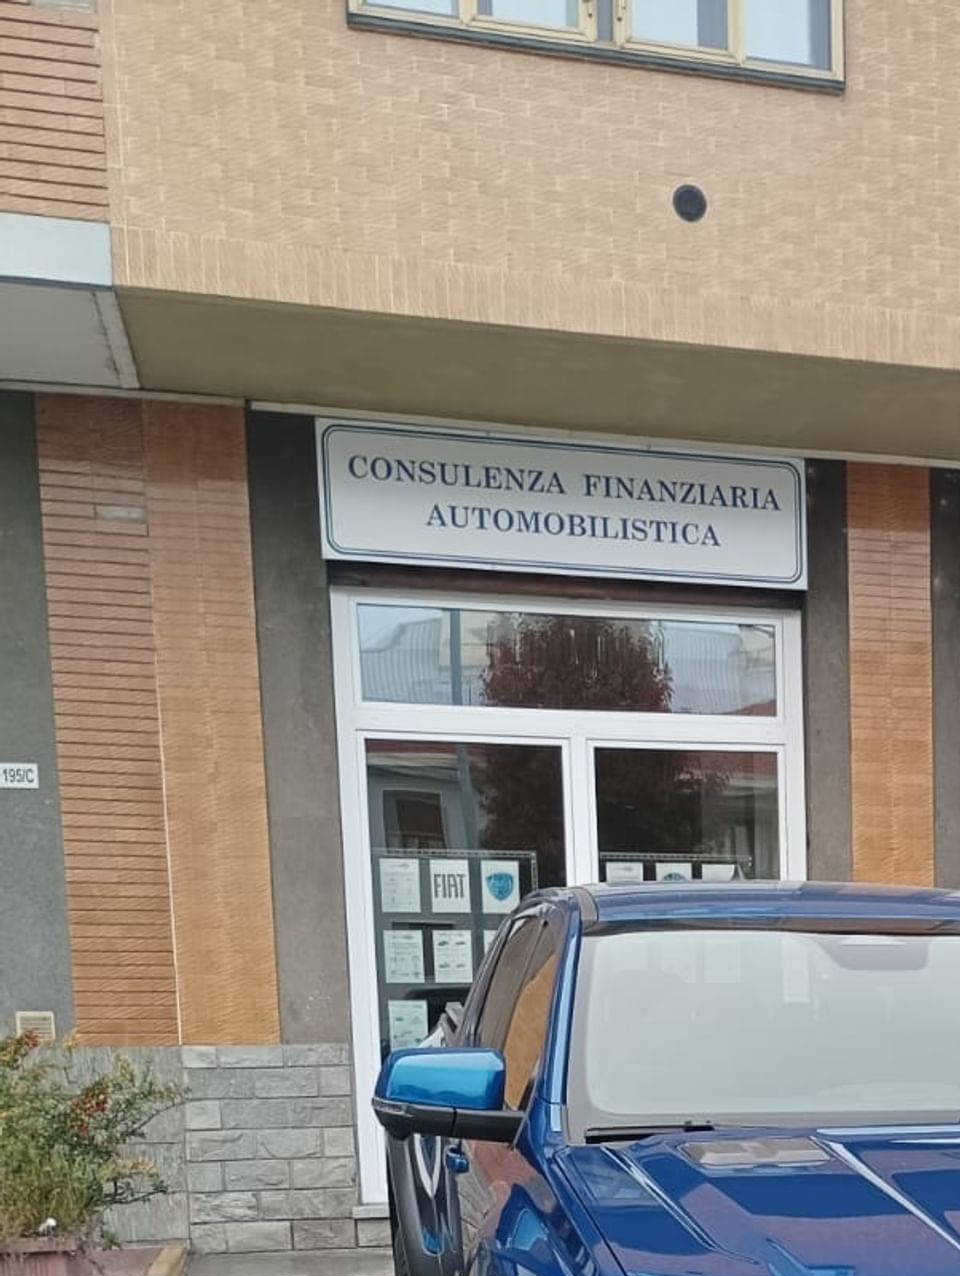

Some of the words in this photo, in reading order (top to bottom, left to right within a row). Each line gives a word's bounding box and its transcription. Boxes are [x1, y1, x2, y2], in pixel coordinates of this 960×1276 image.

[348, 454, 566, 495] CONSULENZA
[583, 474, 782, 511] FINANZIARIA
[426, 504, 721, 547] AUTOMOBILISTICA
[3, 769, 35, 783] 195/C
[434, 874, 466, 898] FIAT
